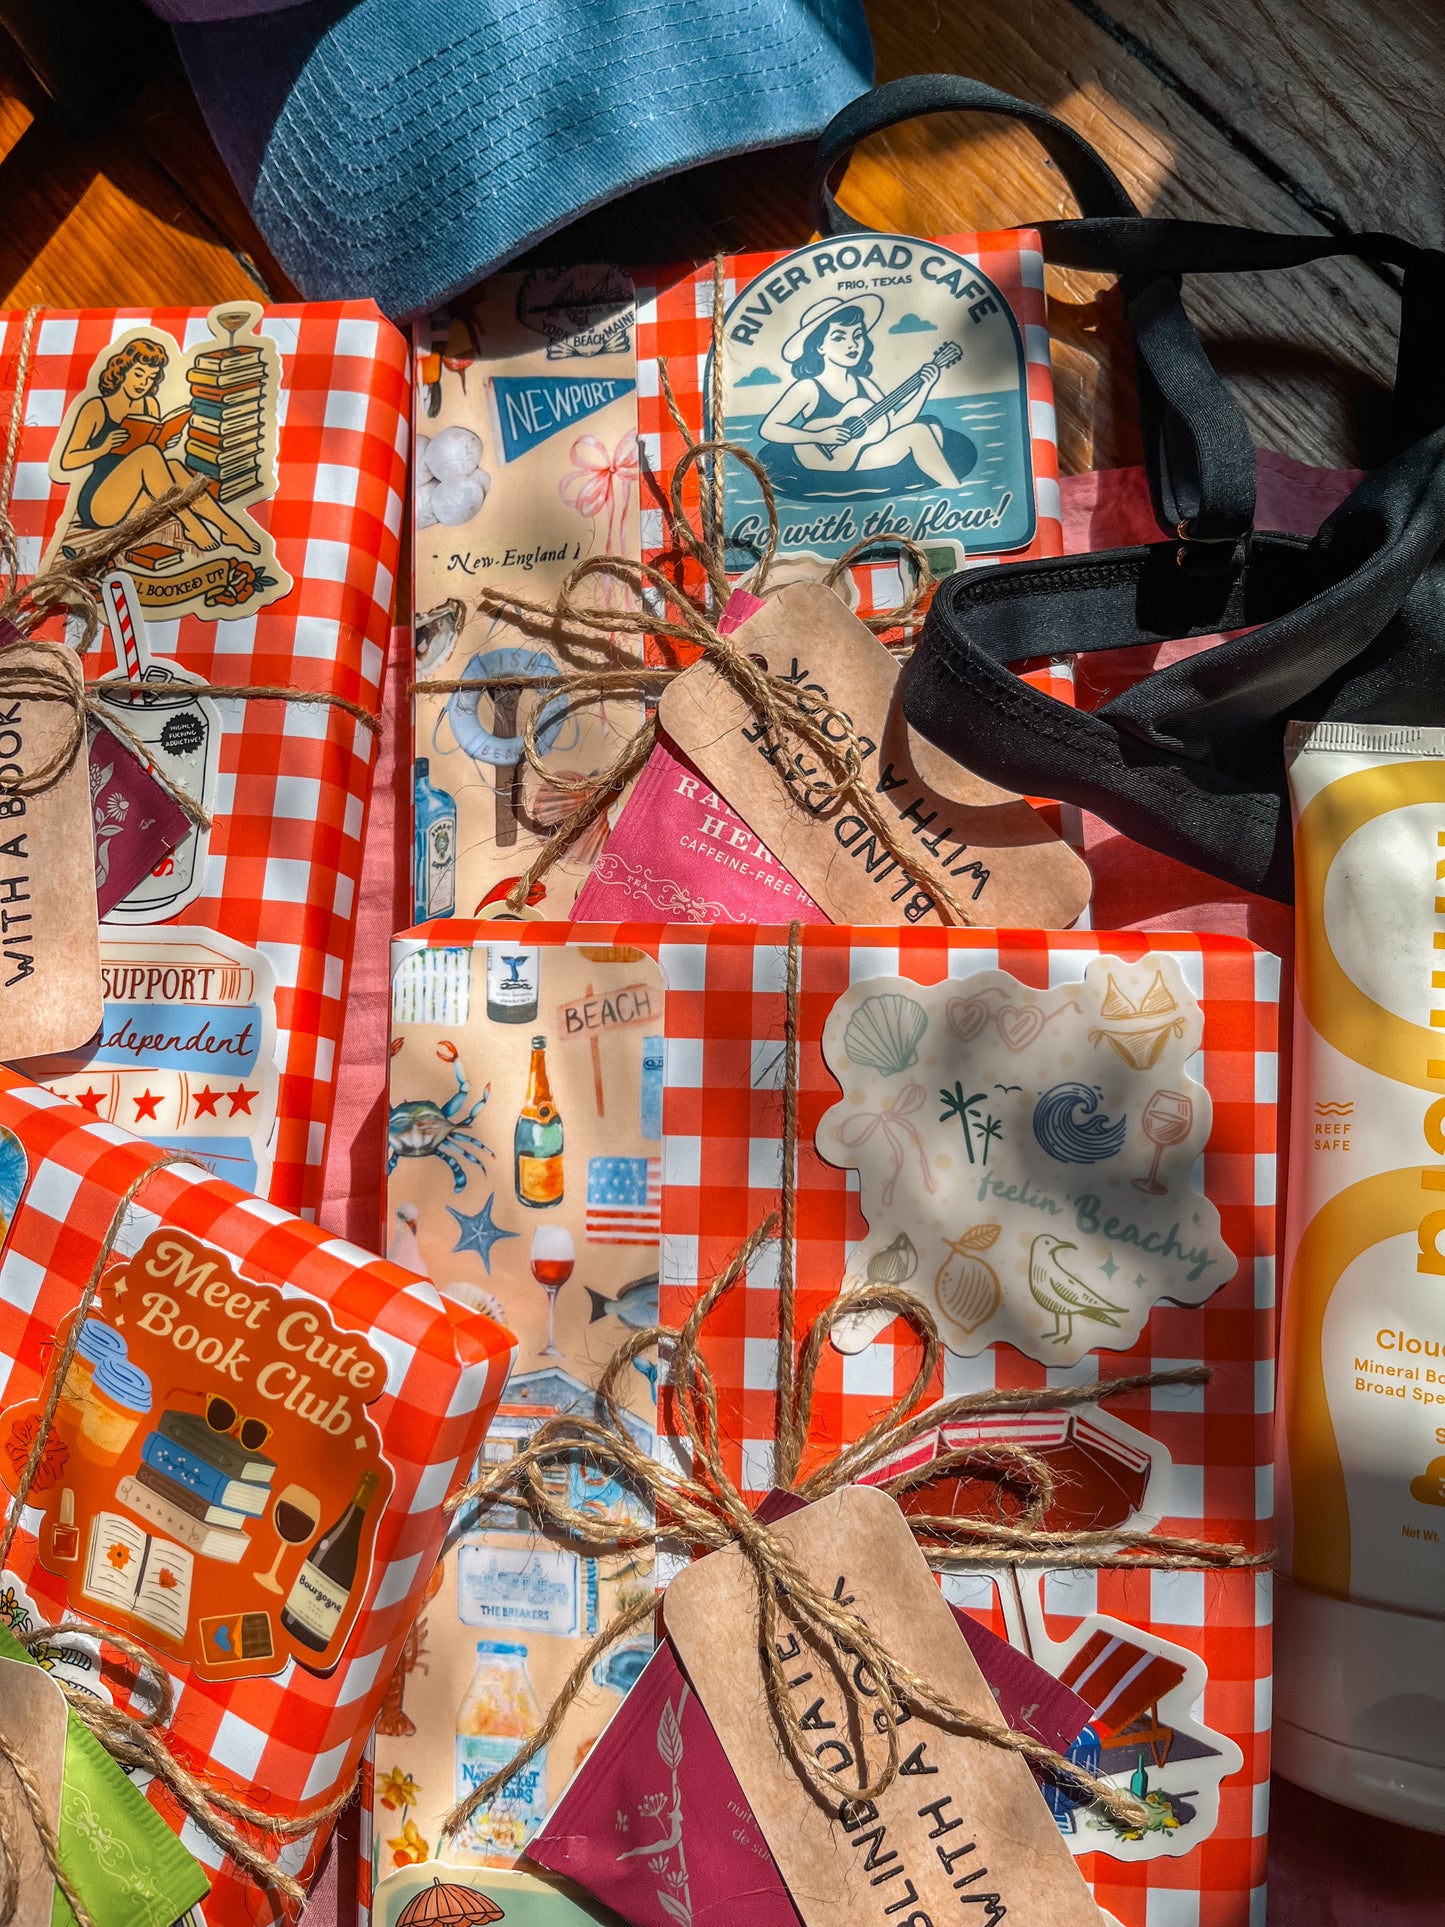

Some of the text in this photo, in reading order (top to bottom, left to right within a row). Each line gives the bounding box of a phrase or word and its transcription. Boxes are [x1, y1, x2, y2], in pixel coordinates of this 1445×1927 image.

[730, 244, 998, 346] RIVER ROAD CAFE
[837, 274, 912, 291] FRIO, TEXAS
[573, 334, 604, 347] BEACH
[505, 381, 616, 441] NEWPORT
[783, 506, 856, 546] with
[863, 502, 911, 536] the
[913, 492, 1012, 540] flow!
[146, 576, 204, 597] BOOKED
[206, 568, 225, 584] UP
[165, 736, 201, 747] ADDICTIVE!
[168, 730, 197, 739] FUCKING
[170, 723, 195, 731] HIGHLY
[776, 657, 990, 900] WITH A BOOK
[0, 833, 28, 858] A
[680, 835, 792, 895] CAFFEINE-FREE
[834, 815, 935, 924] BLIND
[626, 874, 648, 891] TEA
[0, 876, 34, 987] WITH
[101, 968, 215, 1000] SUPPORT
[565, 991, 652, 1034] BEACH
[1315, 1123, 1351, 1134] REEF
[1314, 1139, 1350, 1151] SAFE
[1073, 1193, 1217, 1282] Beachy
[145, 1240, 375, 1388] Meet Cute
[1376, 1328, 1445, 1358] Clou
[136, 1292, 352, 1435] Book Club
[1354, 1357, 1420, 1381] Mineral
[1355, 1377, 1407, 1398] Broad
[1401, 1525, 1440, 1543] Net Wt.
[299, 1574, 342, 1613] Bourgogne
[480, 1605, 550, 1620] THE BREAKERS
[899, 1742, 939, 1776] A
[732, 1828, 750, 1845] de
[917, 1796, 1008, 1927] WITH
